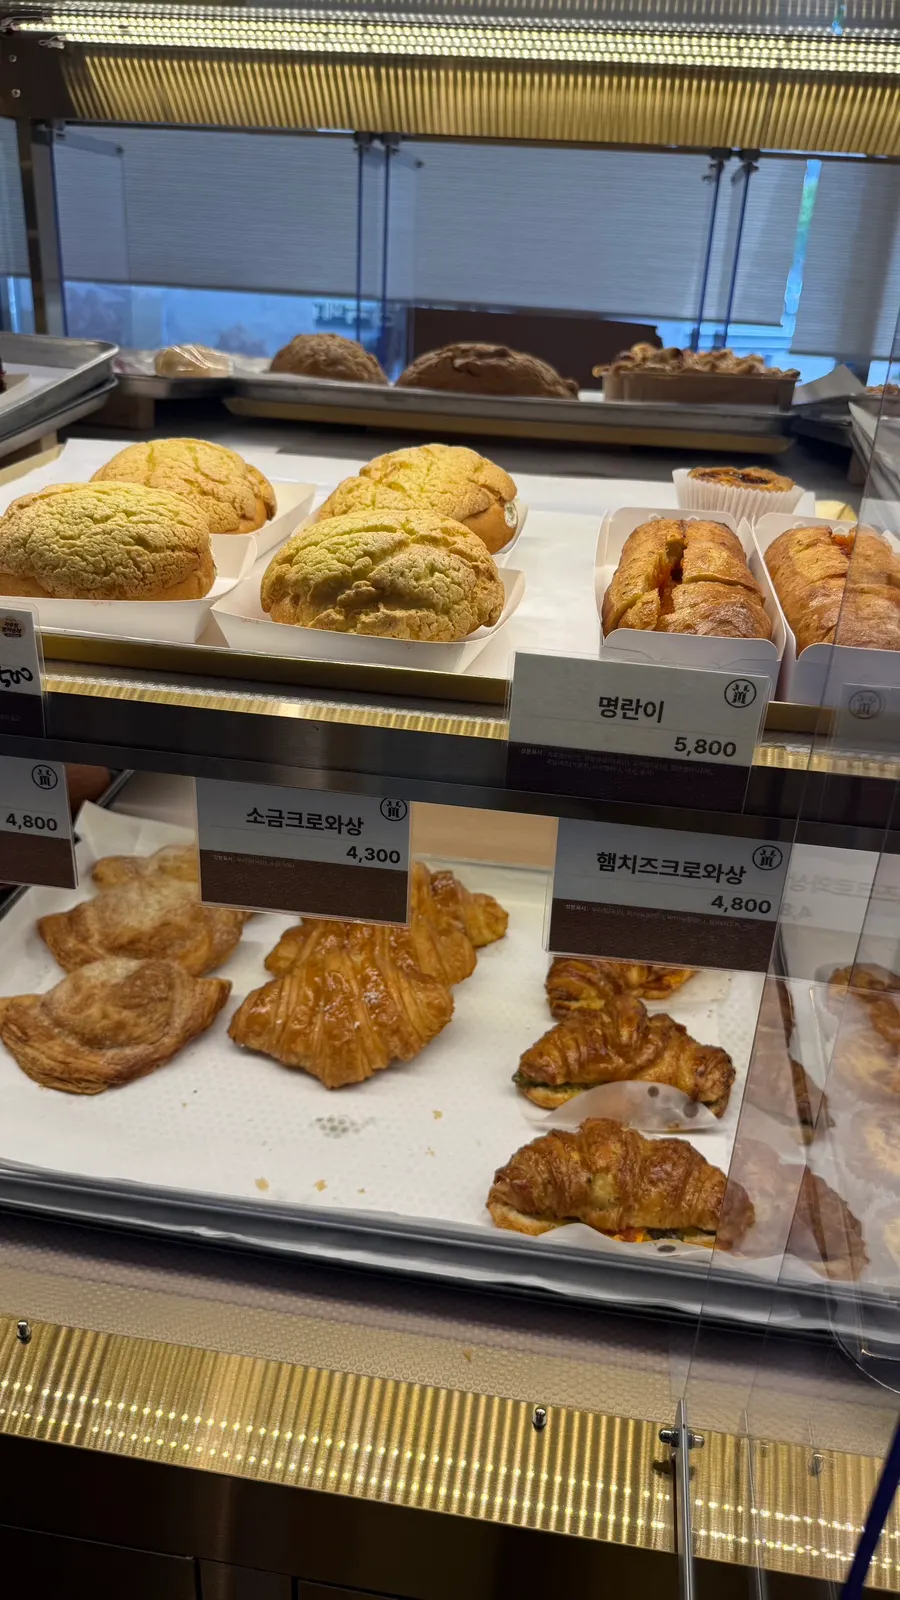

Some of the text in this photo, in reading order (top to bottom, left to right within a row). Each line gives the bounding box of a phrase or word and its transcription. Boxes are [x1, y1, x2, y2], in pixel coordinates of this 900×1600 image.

[599, 696, 664, 723] 명란이
[674, 736, 737, 757] 5,800
[6, 813, 58, 831] 4,800
[246, 807, 364, 836] 소금크로와상
[346, 846, 400, 864] 4,300
[597, 852, 747, 885] 햄치즈크로와상
[711, 895, 772, 914] 4,800
